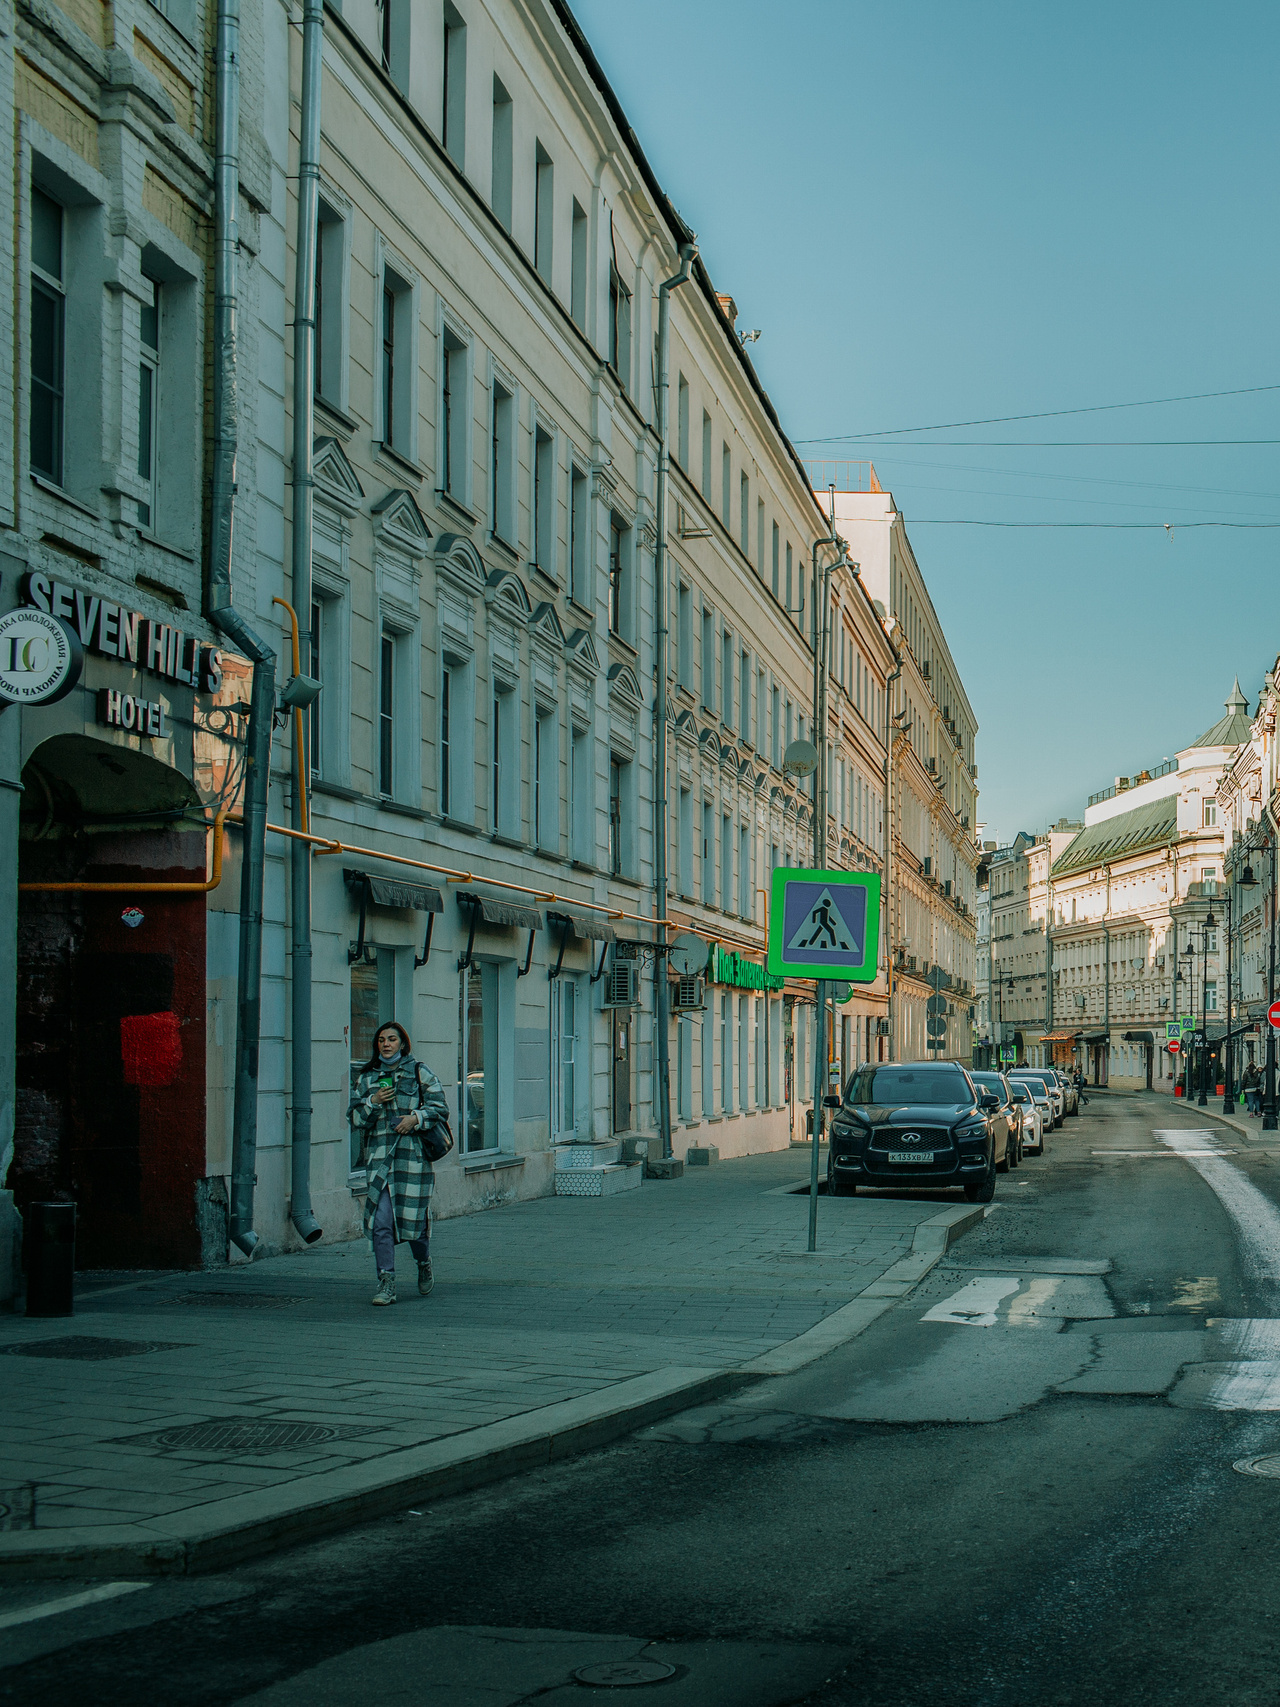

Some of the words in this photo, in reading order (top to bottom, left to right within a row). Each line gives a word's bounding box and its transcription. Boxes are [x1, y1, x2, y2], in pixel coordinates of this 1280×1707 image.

[17, 613, 66, 658] ОМОЛОЖЕНИЯ
[27, 572, 139, 663] SEVEN
[145, 619, 222, 694] HILLS
[106, 688, 170, 738] HOTEL
